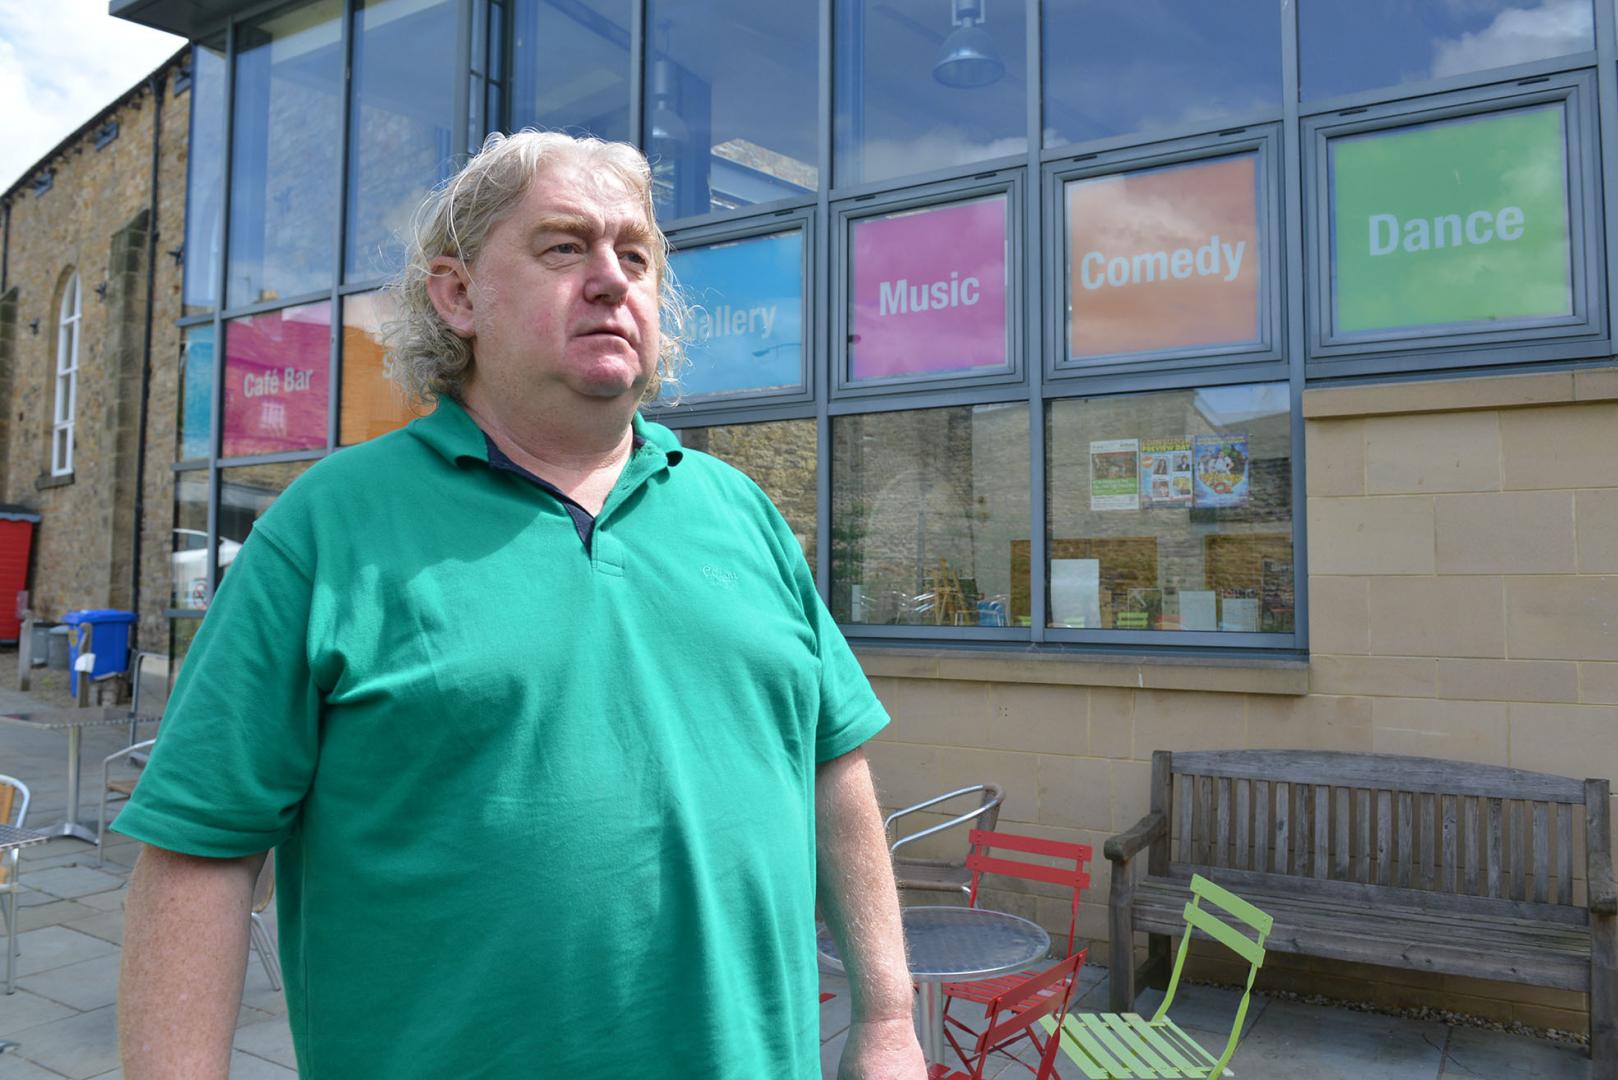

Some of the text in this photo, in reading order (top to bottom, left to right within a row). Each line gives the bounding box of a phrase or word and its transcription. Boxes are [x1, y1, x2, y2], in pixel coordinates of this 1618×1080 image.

[1368, 206, 1525, 257] Dance
[1080, 234, 1246, 290] Comedy
[879, 271, 980, 316] Music
[243, 367, 313, 398] Café Bar
